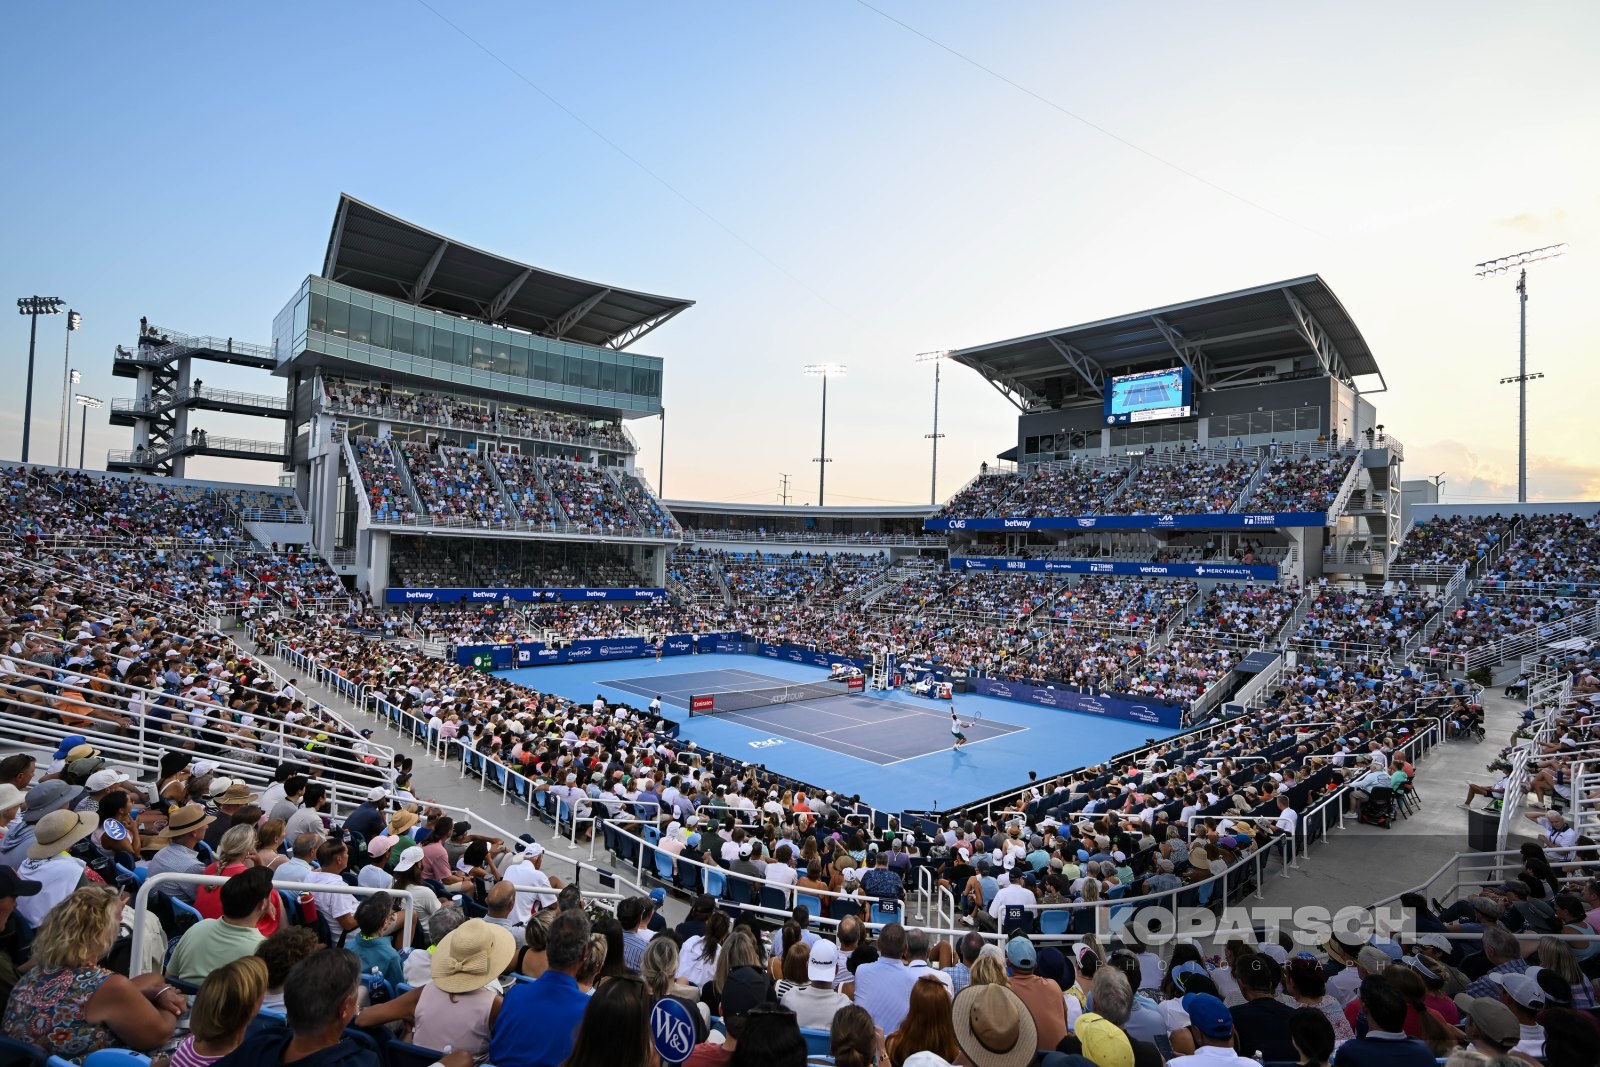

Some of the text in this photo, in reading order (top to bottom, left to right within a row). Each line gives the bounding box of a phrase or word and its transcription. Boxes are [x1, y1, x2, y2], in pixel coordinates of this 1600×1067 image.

[1004, 519, 1031, 528] betway
[1139, 565, 1168, 573] verizon
[406, 591, 434, 600] betway
[472, 591, 497, 599] betway
[586, 590, 607, 598] betway
[693, 700, 713, 708] Emirates
[748, 737, 785, 749] P&G
[882, 903, 894, 911] 105
[1009, 910, 1021, 918] 105
[655, 1006, 691, 1054] W&S
